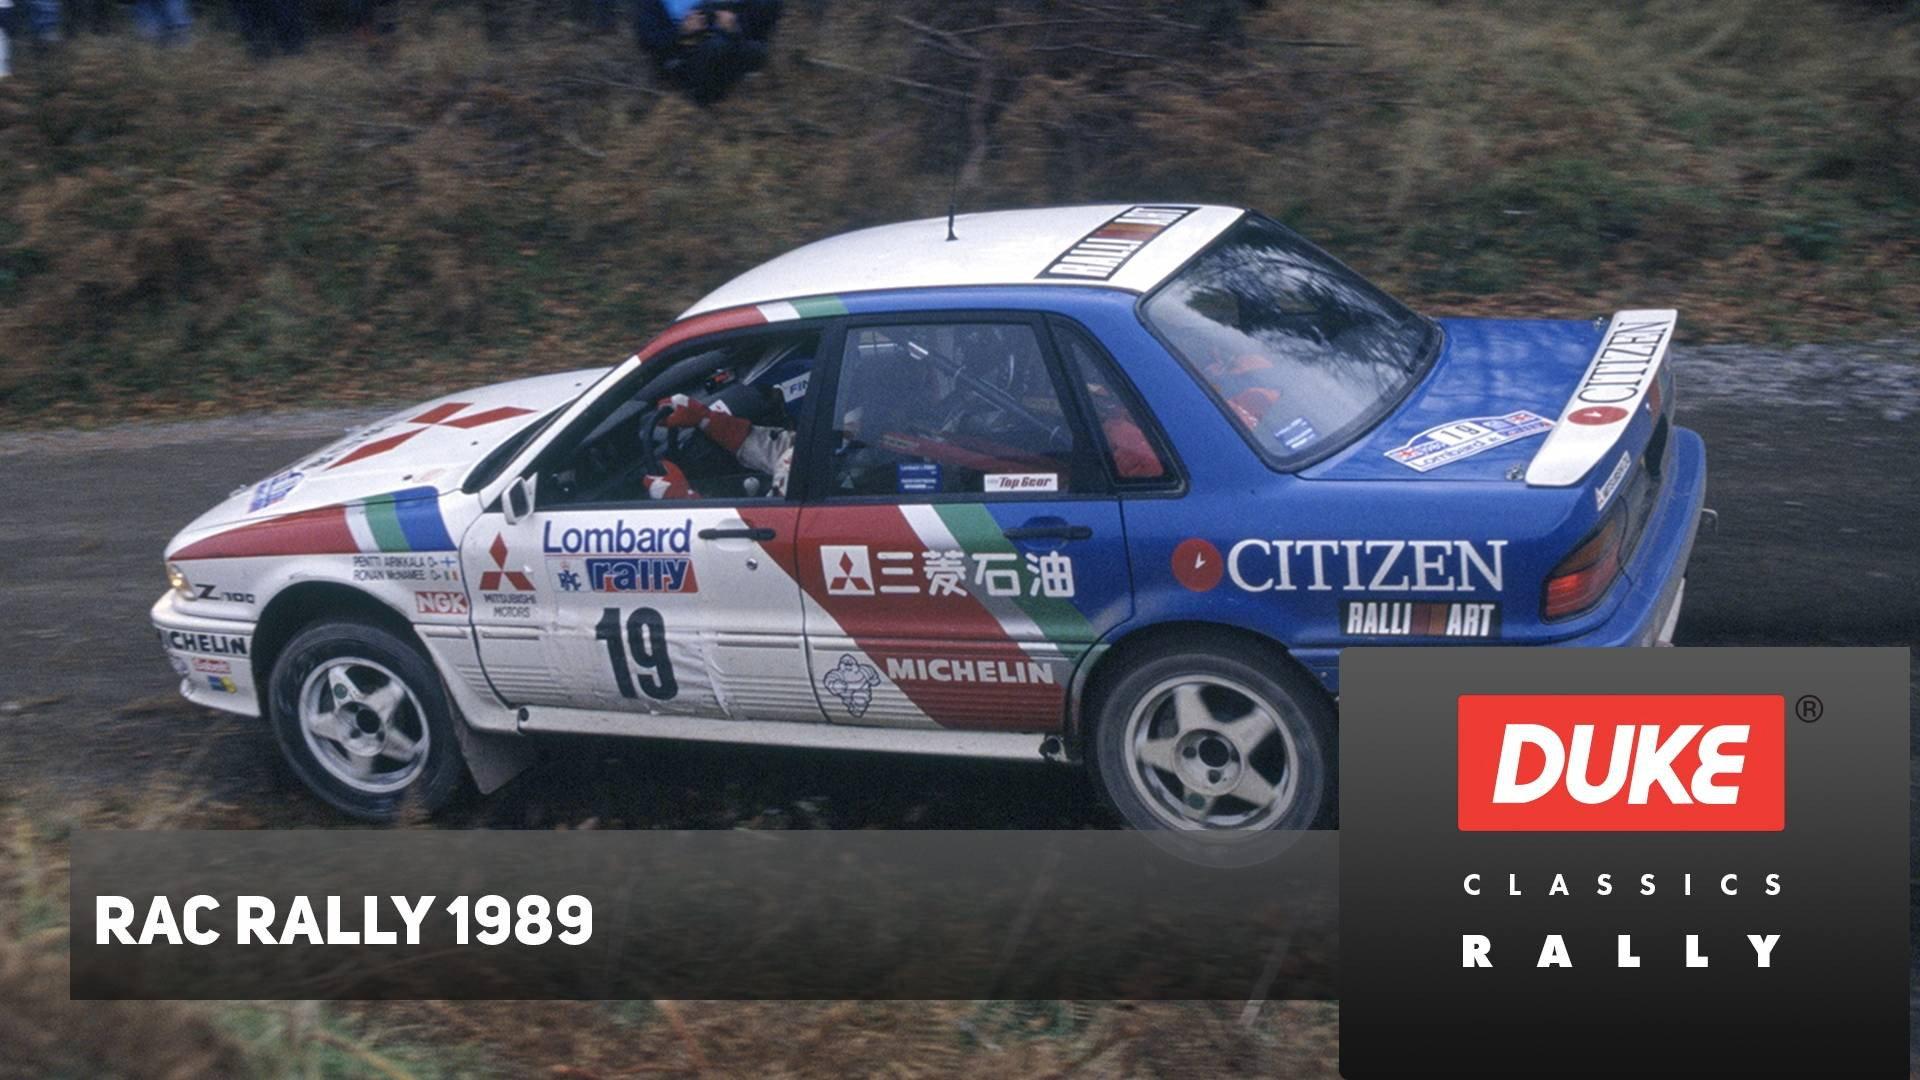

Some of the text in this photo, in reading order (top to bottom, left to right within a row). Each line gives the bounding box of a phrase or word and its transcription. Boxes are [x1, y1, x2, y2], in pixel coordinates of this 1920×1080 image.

[1578, 320, 1672, 404] CITIZEN
[1000, 477, 1020, 489] Top
[1021, 476, 1053, 488] Gear
[543, 519, 693, 554] Lombard
[592, 558, 690, 592] rally
[876, 550, 1075, 598] 三菱石油
[1226, 539, 1509, 593] CITIZEN
[416, 592, 468, 614] NGK
[493, 605, 530, 618] MOTORS
[1346, 602, 1496, 636] RALLI ART
[595, 606, 679, 700] 19
[886, 657, 1055, 685] MICHELIN
